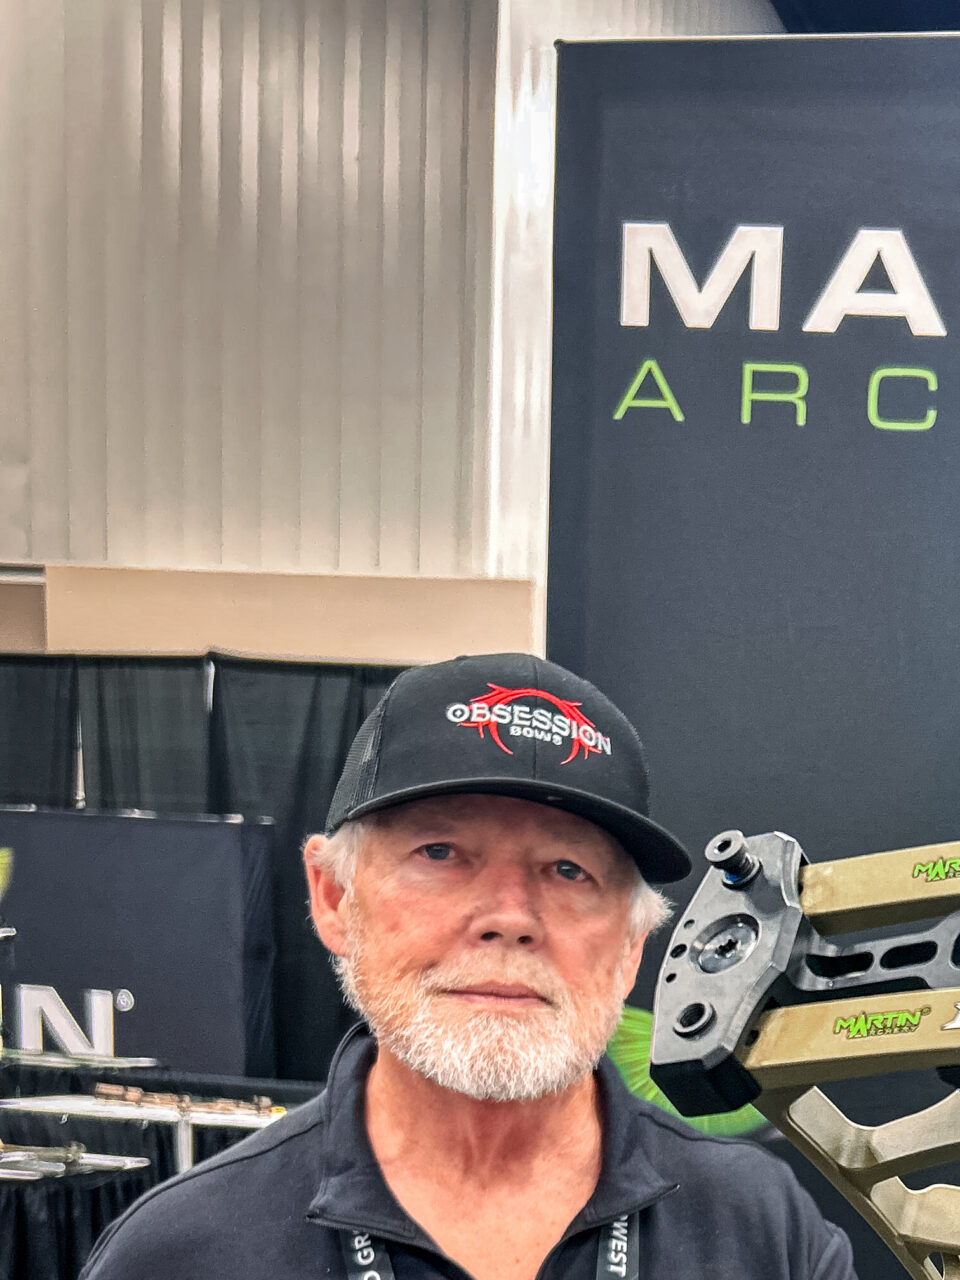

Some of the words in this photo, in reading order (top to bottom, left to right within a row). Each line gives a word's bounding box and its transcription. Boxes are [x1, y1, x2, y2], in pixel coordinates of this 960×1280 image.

[446, 702, 612, 755] OBSESSION
[510, 726, 563, 745] BOWS
[354, 1229, 375, 1266] GR
[607, 1214, 629, 1278] WEST
